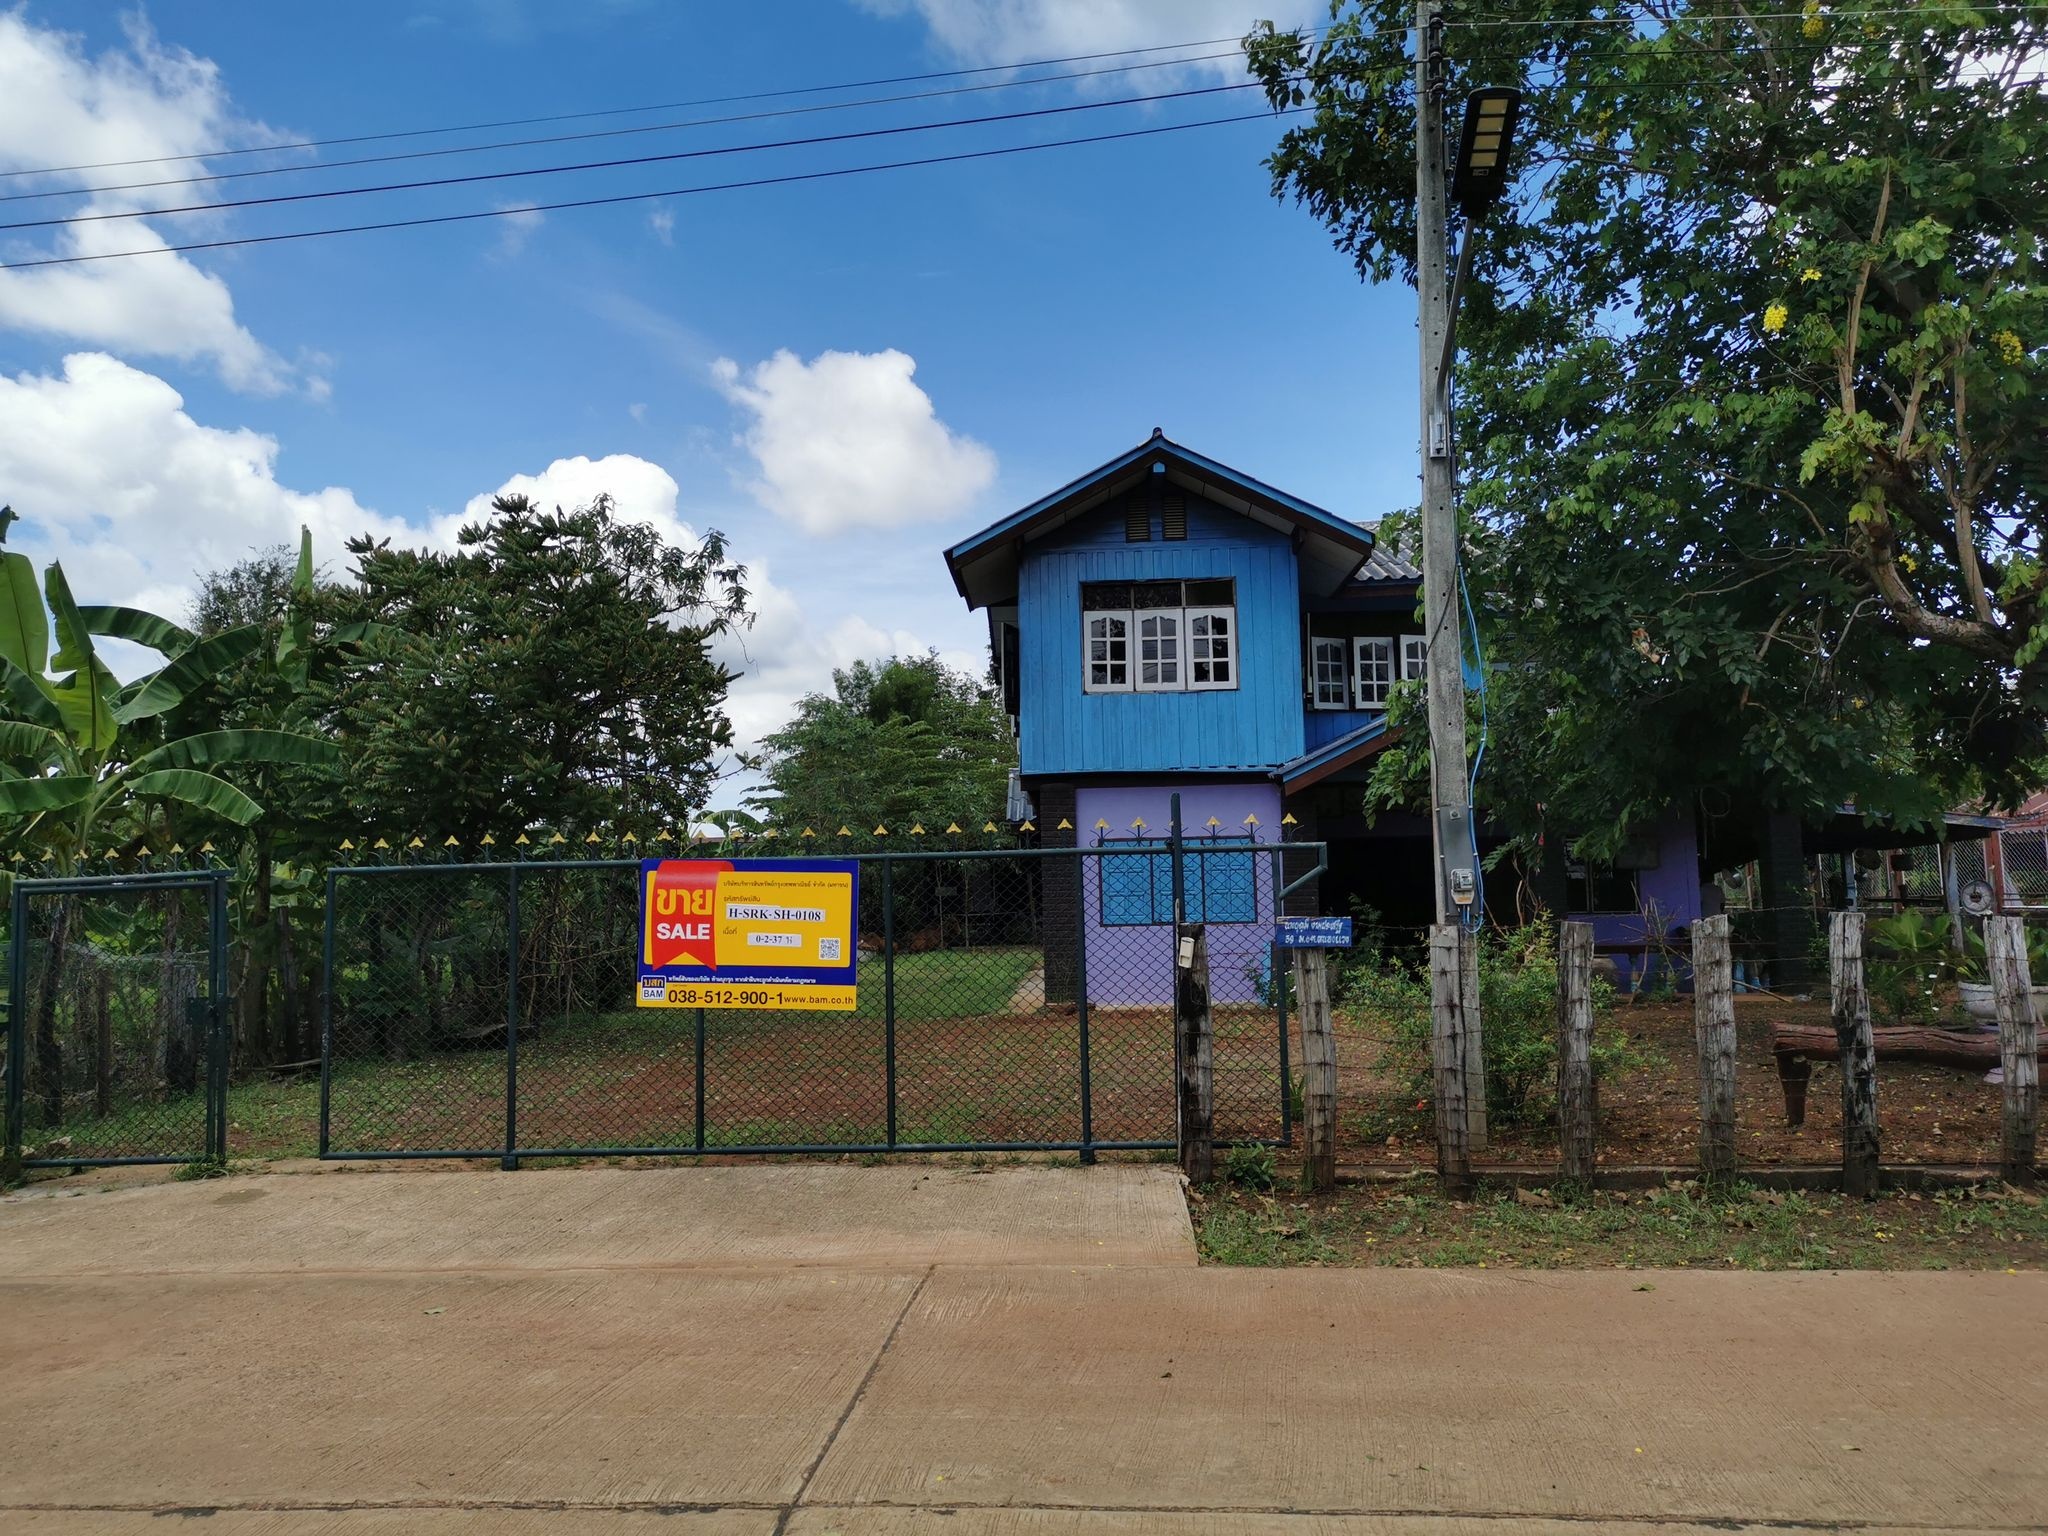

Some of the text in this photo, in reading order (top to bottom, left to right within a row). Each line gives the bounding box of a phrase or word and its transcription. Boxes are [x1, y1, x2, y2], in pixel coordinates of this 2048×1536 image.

[656, 889, 713, 916] ขาย
[728, 908, 821, 921] H-SRK-SH-0108
[656, 923, 711, 940] SALE
[755, 935, 783, 944] 0-2-37
[643, 979, 664, 988] บสก
[643, 988, 664, 999] BAM
[668, 990, 854, 1005] 038-512-900-1 www.bam.co.th
